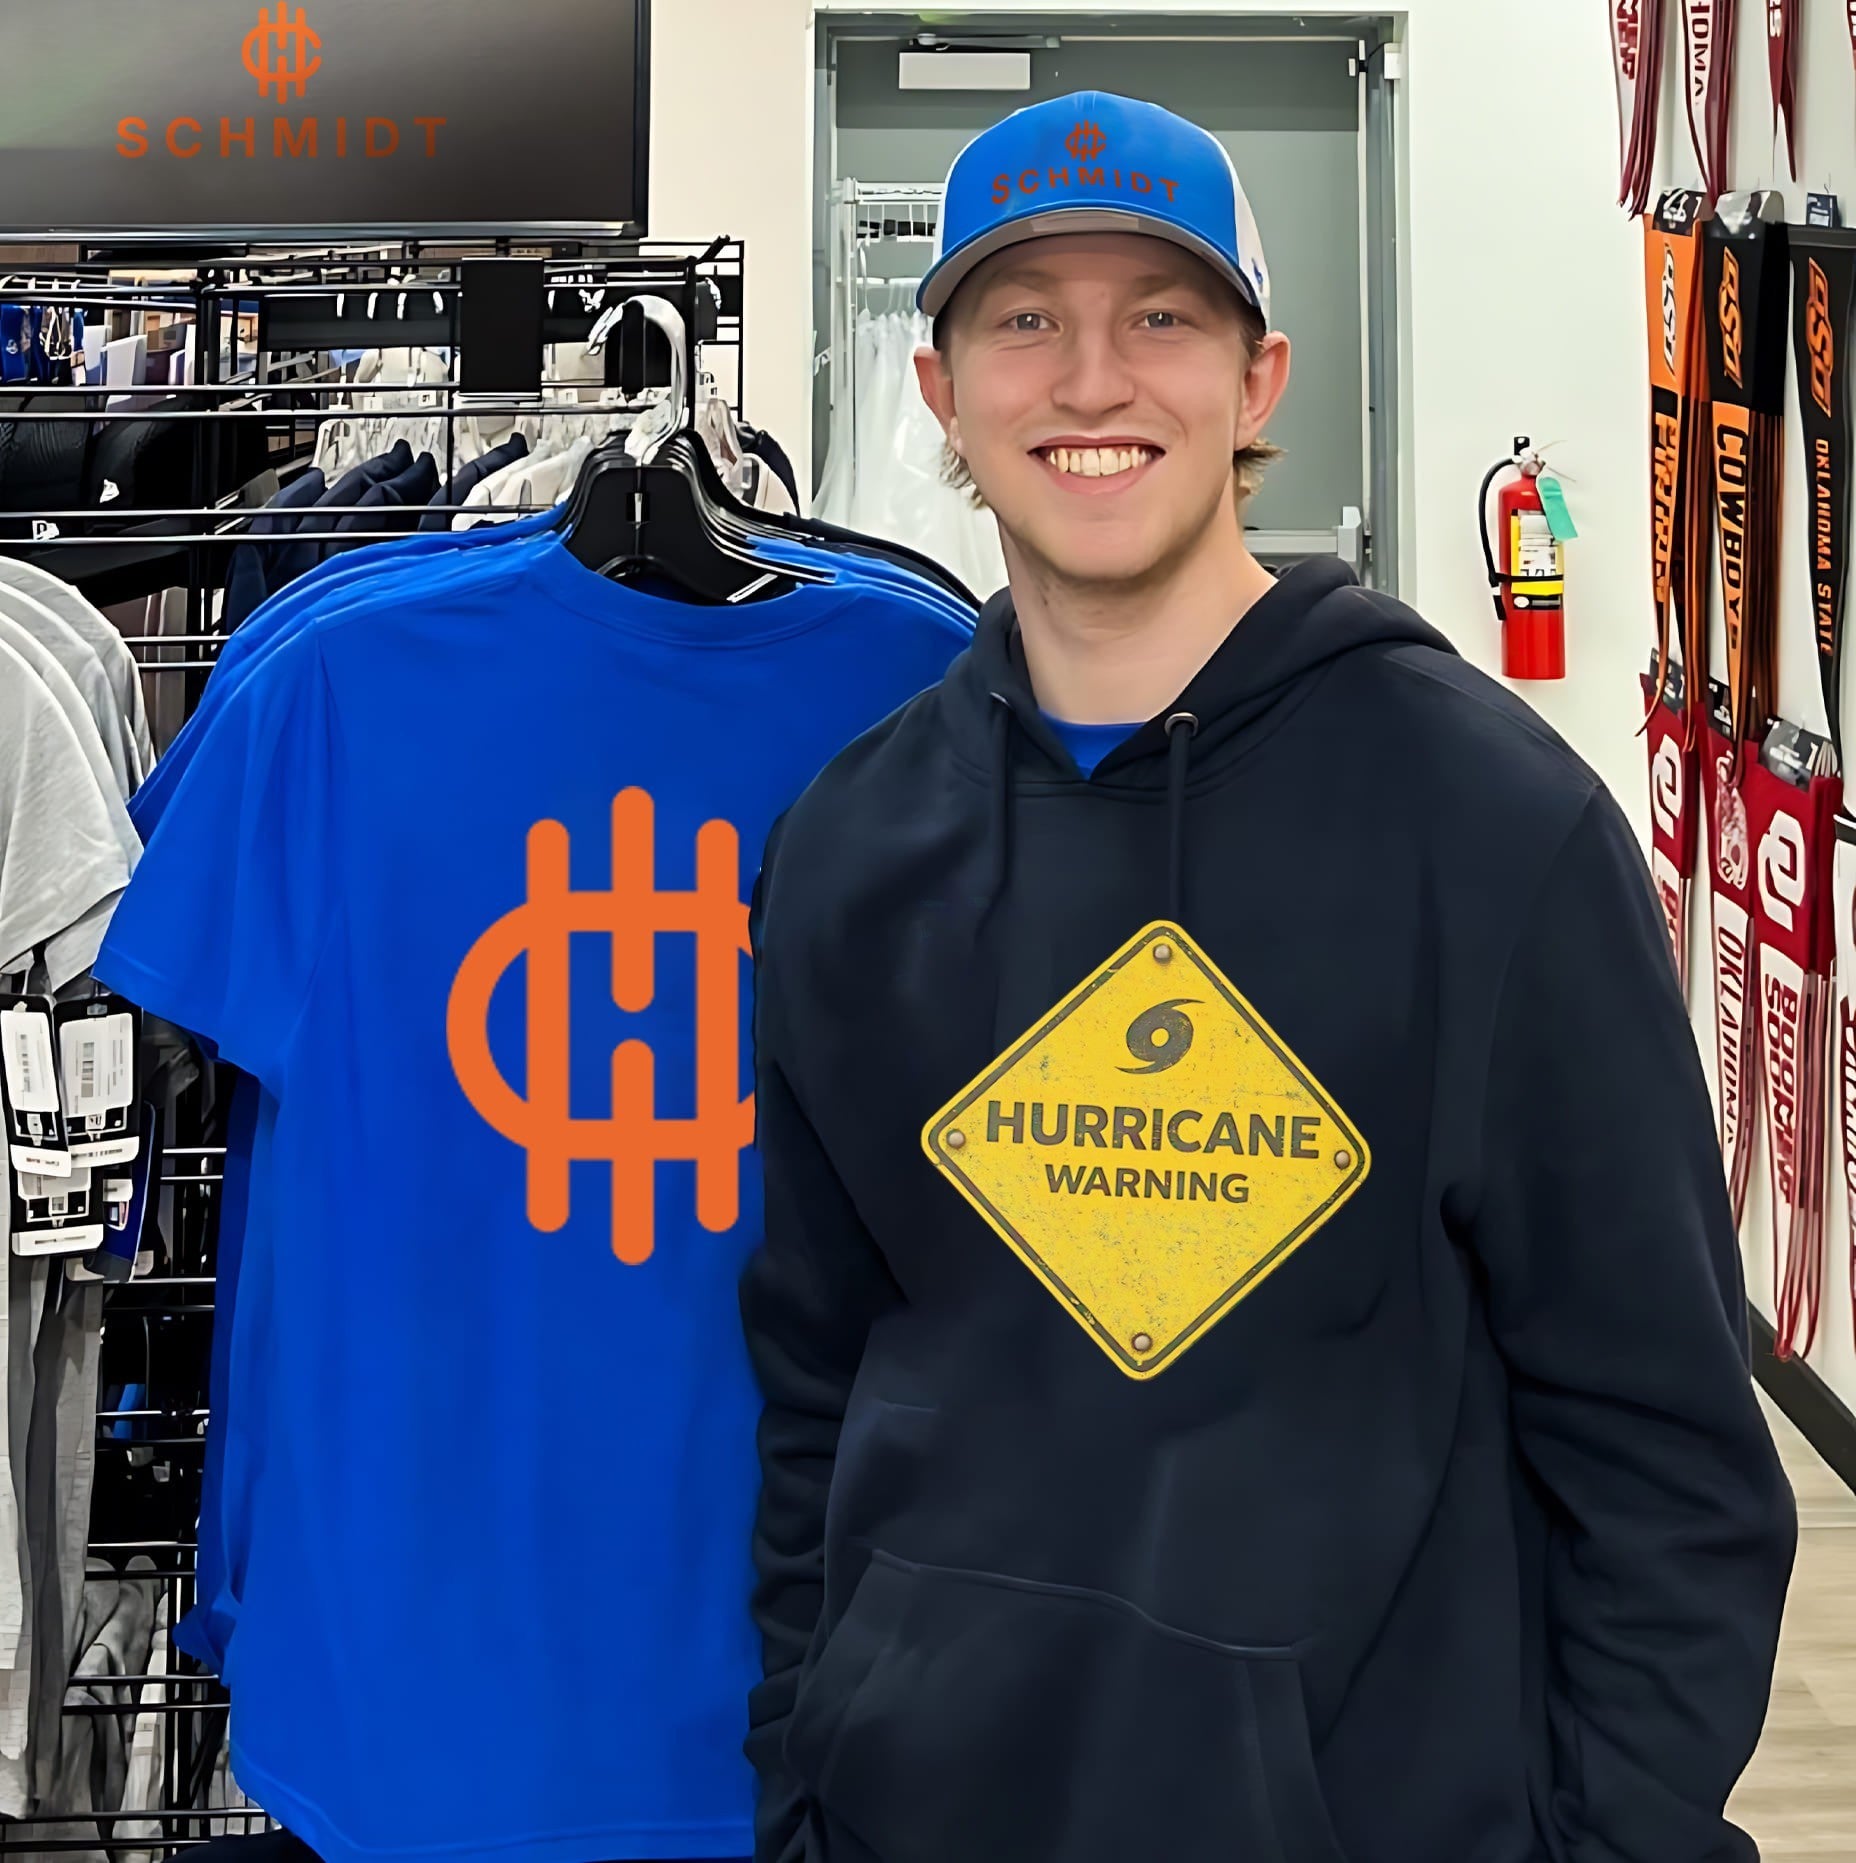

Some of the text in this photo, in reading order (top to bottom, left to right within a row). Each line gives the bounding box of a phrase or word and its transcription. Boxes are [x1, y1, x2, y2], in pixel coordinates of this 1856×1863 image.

[116, 116, 447, 158] SCHMIDT
[992, 167, 1179, 204] SCHMIDT
[1815, 438, 1832, 570] OKLAHOMA
[986, 1100, 1321, 1159] HURRICANE
[1045, 1164, 1249, 1203] WARNING
